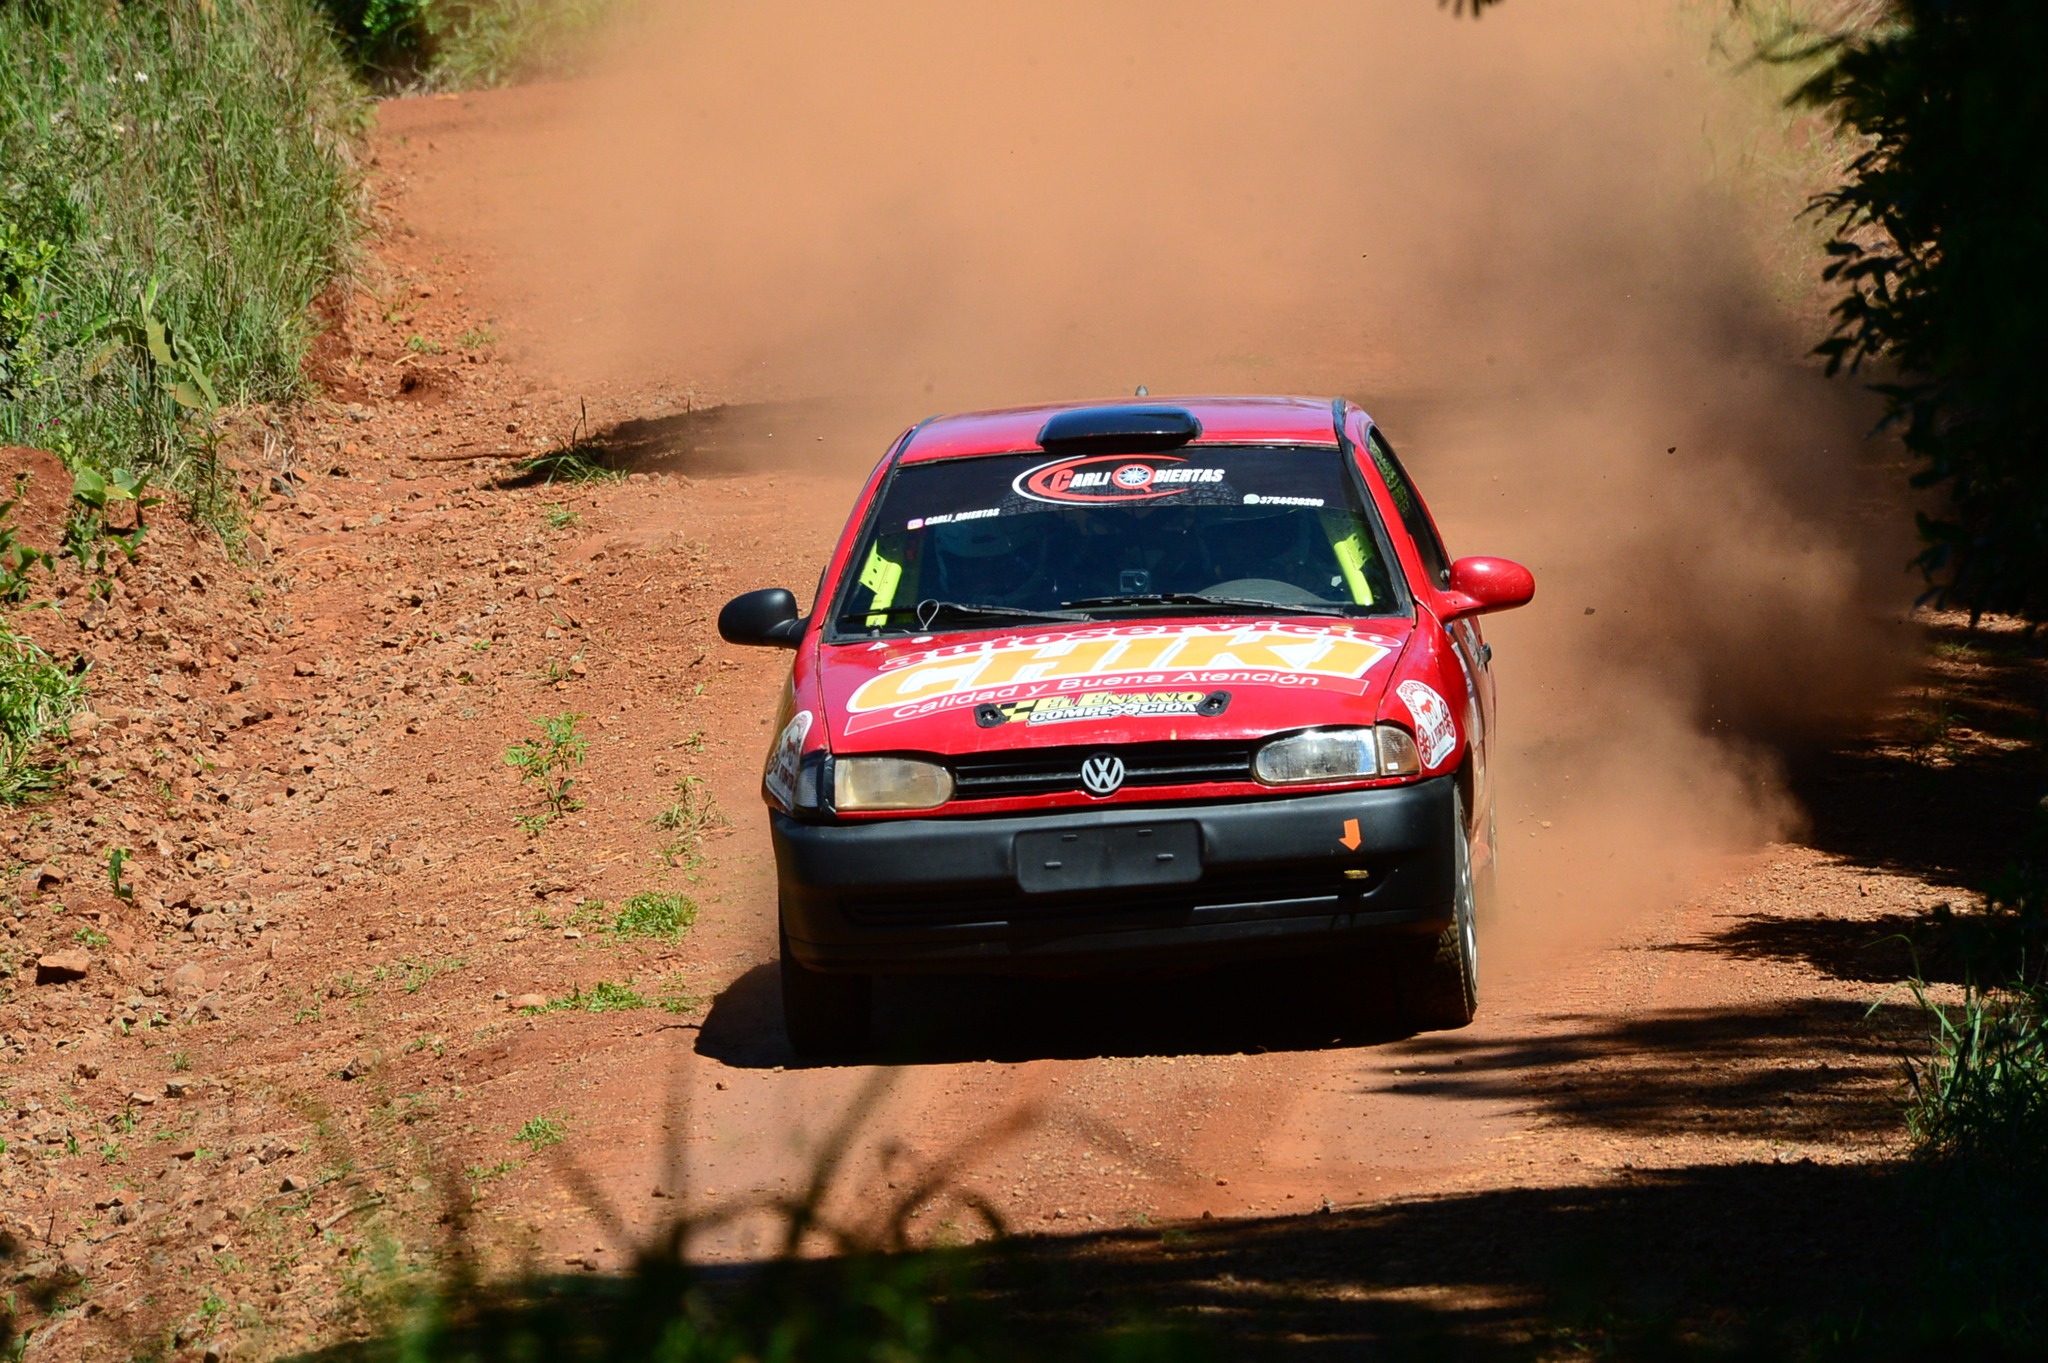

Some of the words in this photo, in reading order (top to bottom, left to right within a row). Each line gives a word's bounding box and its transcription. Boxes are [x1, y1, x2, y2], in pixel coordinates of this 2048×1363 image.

[1050, 469, 1111, 492] CARLI
[879, 620, 1402, 671] autoservicio
[847, 634, 1391, 713] CHIKI
[893, 684, 1020, 719] Calidad
[1026, 683, 1049, 697] y
[1056, 674, 1167, 692] Buena
[1171, 671, 1320, 686] Atención
[1037, 695, 1077, 711] EL
[1077, 691, 1206, 706] ENANO
[1082, 753, 1125, 793] VW
